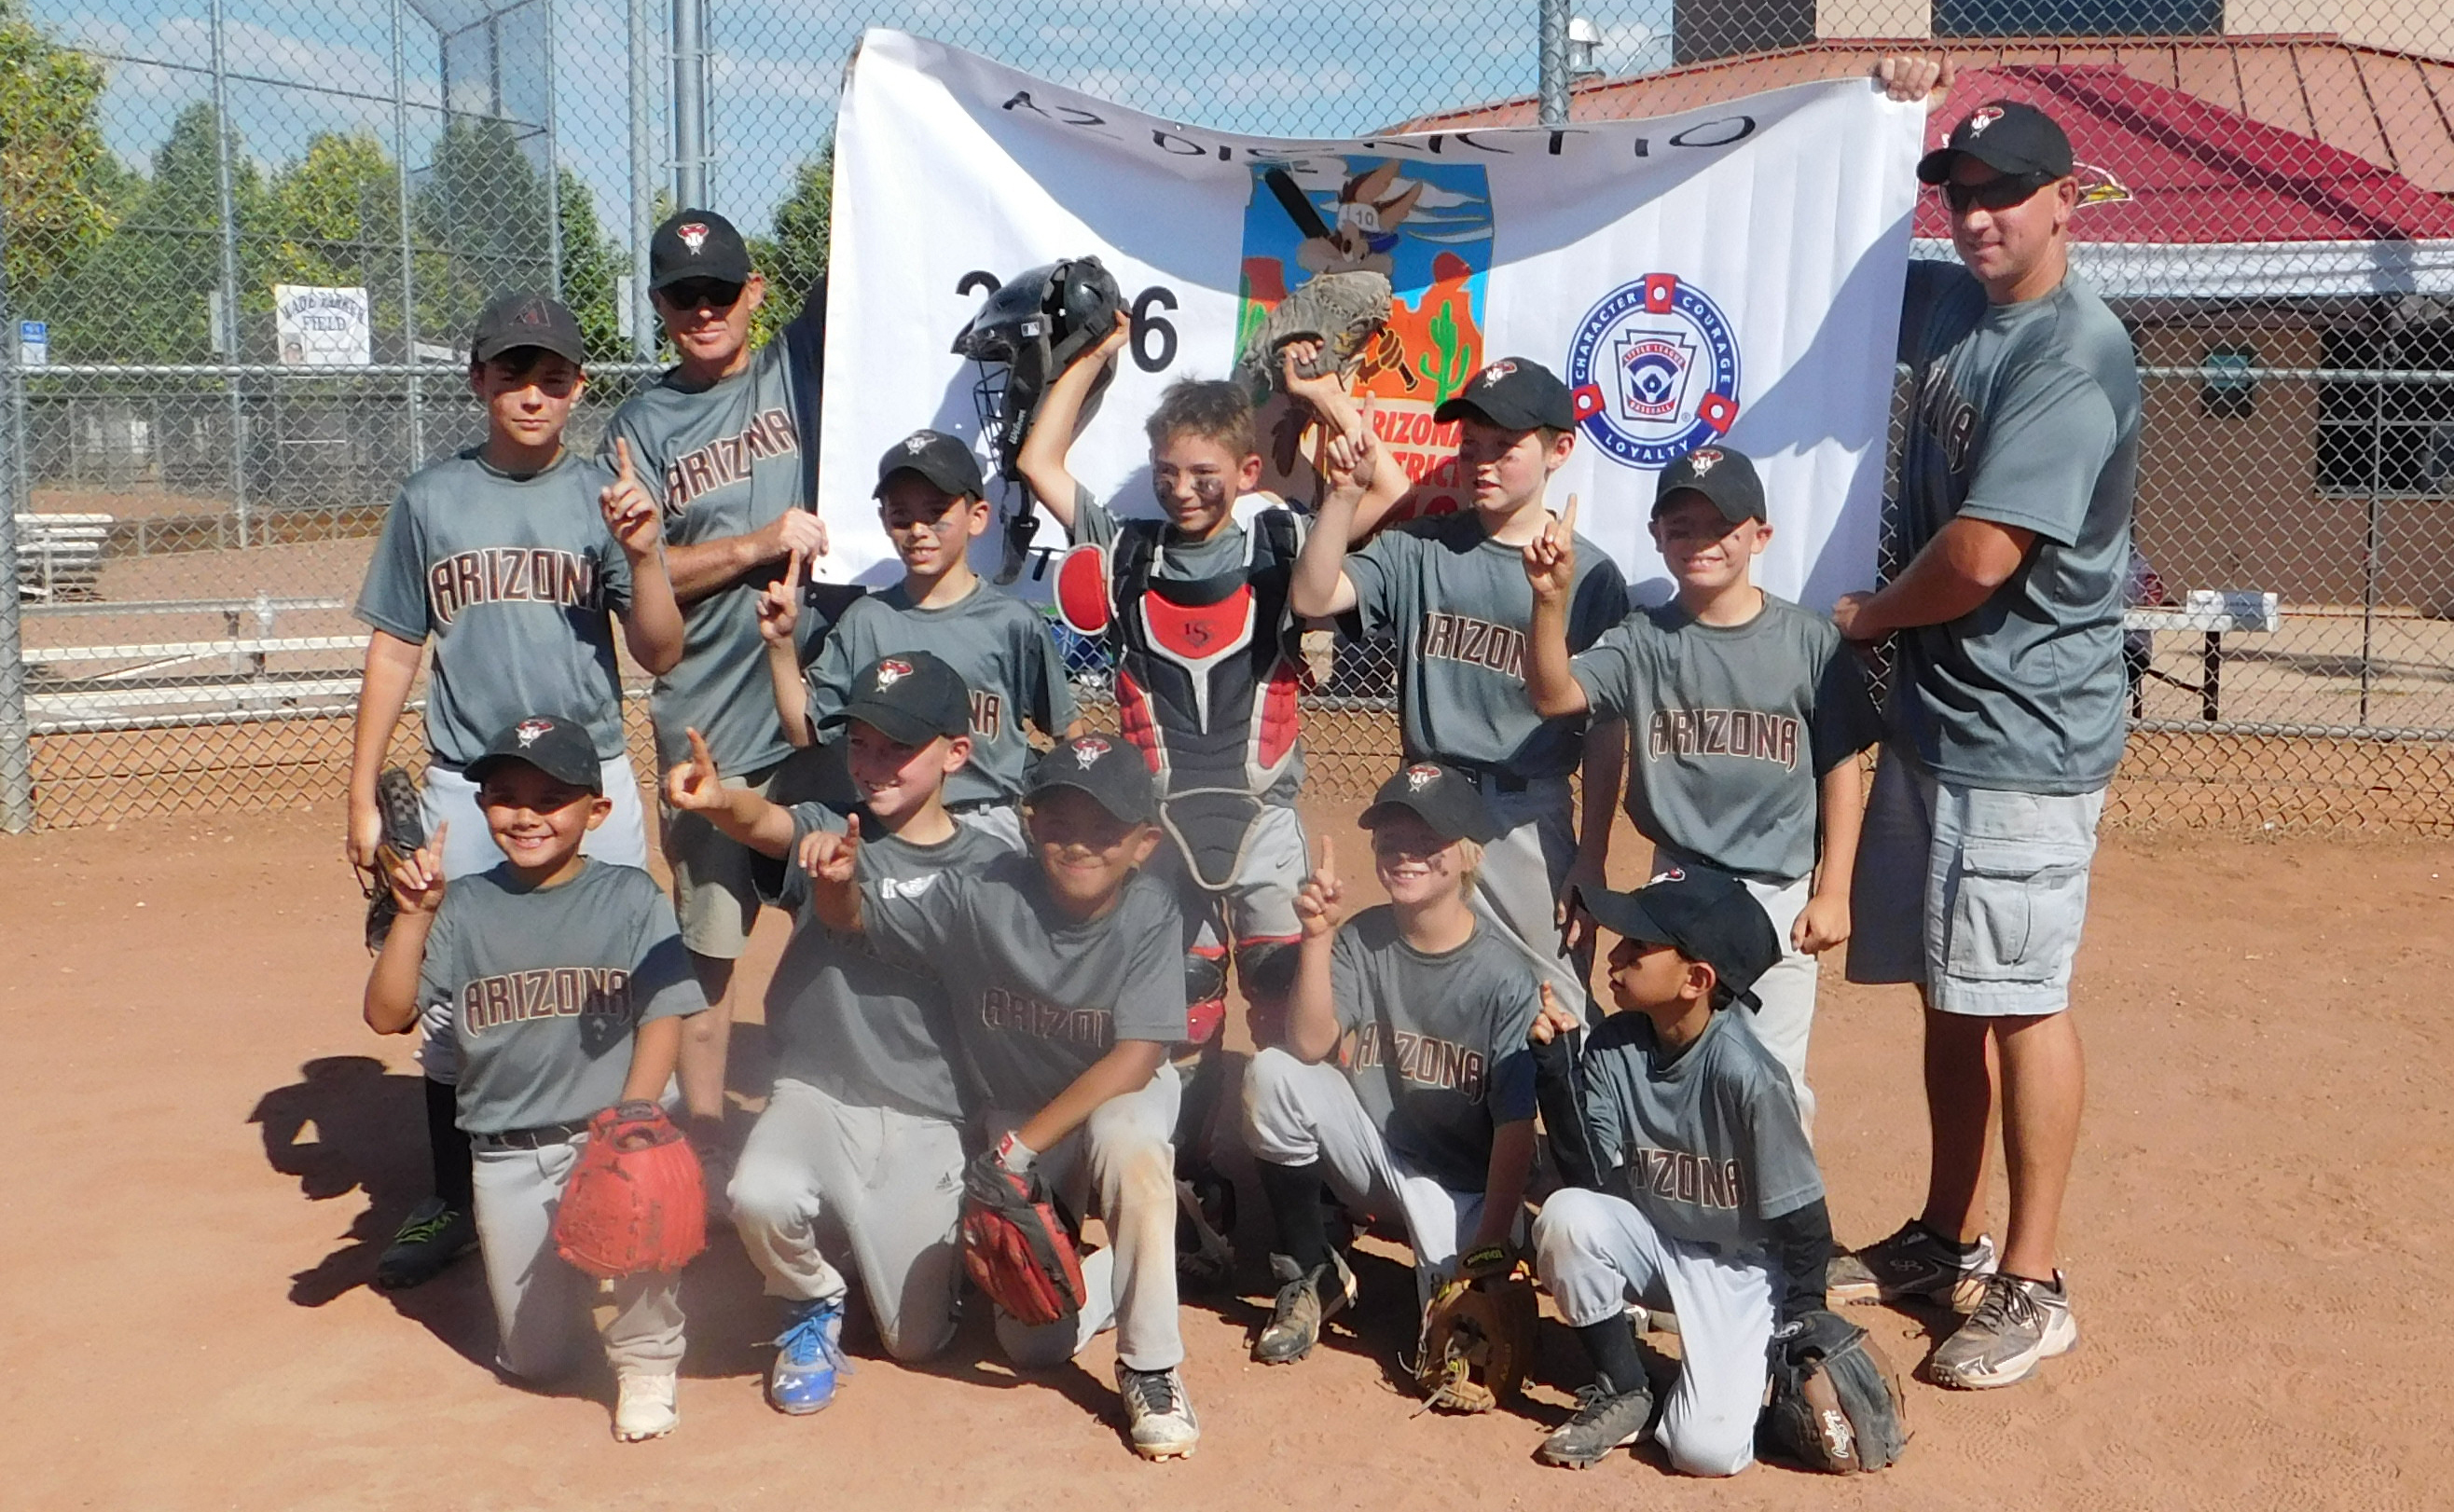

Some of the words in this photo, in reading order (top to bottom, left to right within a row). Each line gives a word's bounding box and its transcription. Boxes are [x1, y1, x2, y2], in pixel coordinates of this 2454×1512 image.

[1634, 116, 1757, 158] 10
[1357, 211, 1374, 227] 10
[302, 316, 347, 331] FIELD
[1576, 293, 1637, 380] CHARACTER
[1623, 345, 1651, 364] LITTLE
[1654, 345, 1687, 366] LEAGUE
[1682, 296, 1731, 384] COURAGE
[1357, 408, 1467, 448] RIZONA
[1631, 400, 1672, 414] BASEBALL
[663, 407, 800, 518] ARIZNA
[1606, 433, 1689, 460] LOYALTY
[1413, 611, 1527, 681] RIZON
[1647, 708, 1799, 774] ARIZONA
[462, 967, 634, 1038] ARIZONA
[982, 986, 1112, 1049] ARIZO
[1355, 1020, 1485, 1106] AZONA
[1622, 1139, 1747, 1210] IZONA
